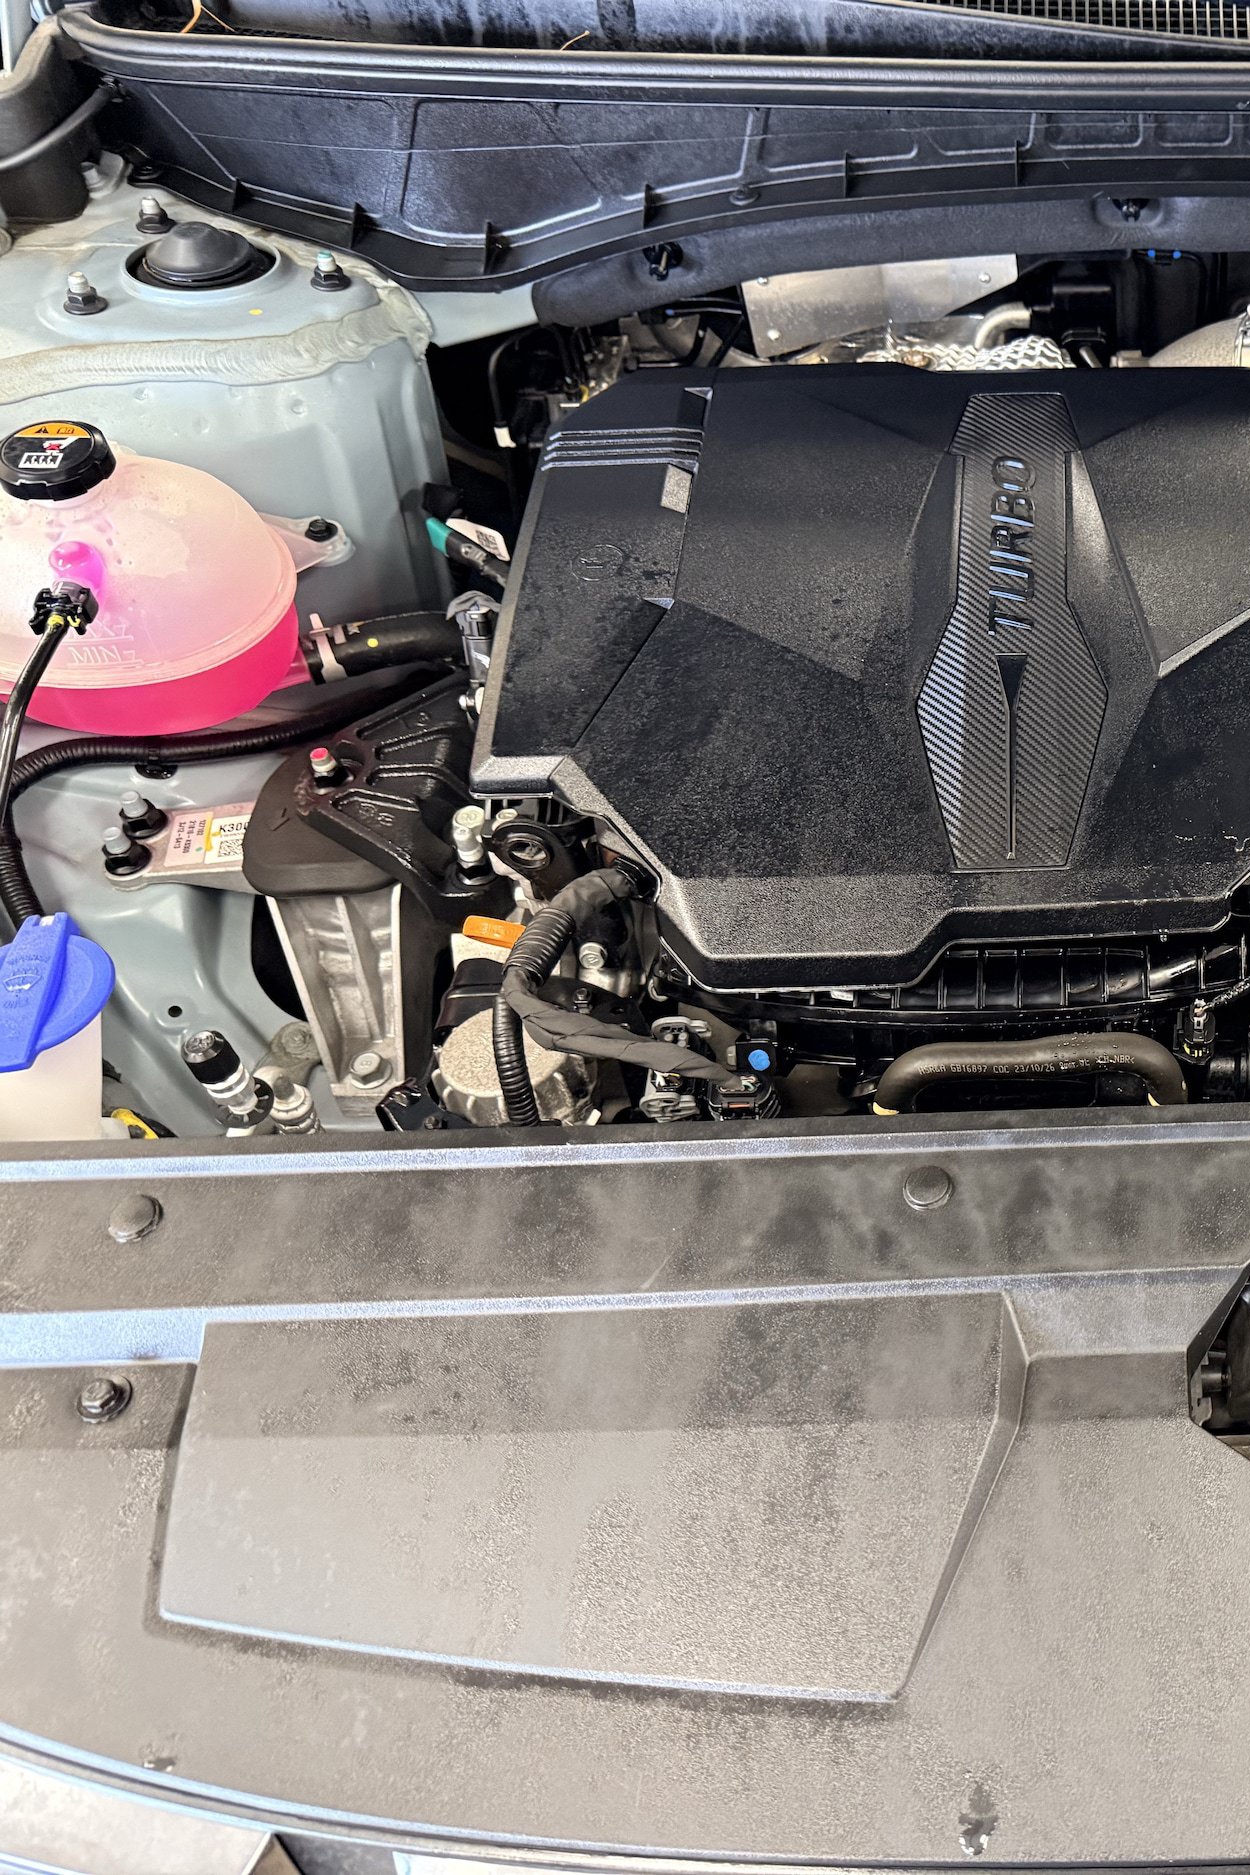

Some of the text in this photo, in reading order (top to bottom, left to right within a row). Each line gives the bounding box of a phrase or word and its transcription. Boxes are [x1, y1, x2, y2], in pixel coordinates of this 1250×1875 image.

[988, 455, 1037, 636] TURBO
[67, 645, 122, 665] MIN
[950, 1063, 987, 1073] GB16897
[1014, 1062, 1055, 1073] 23/10/26
